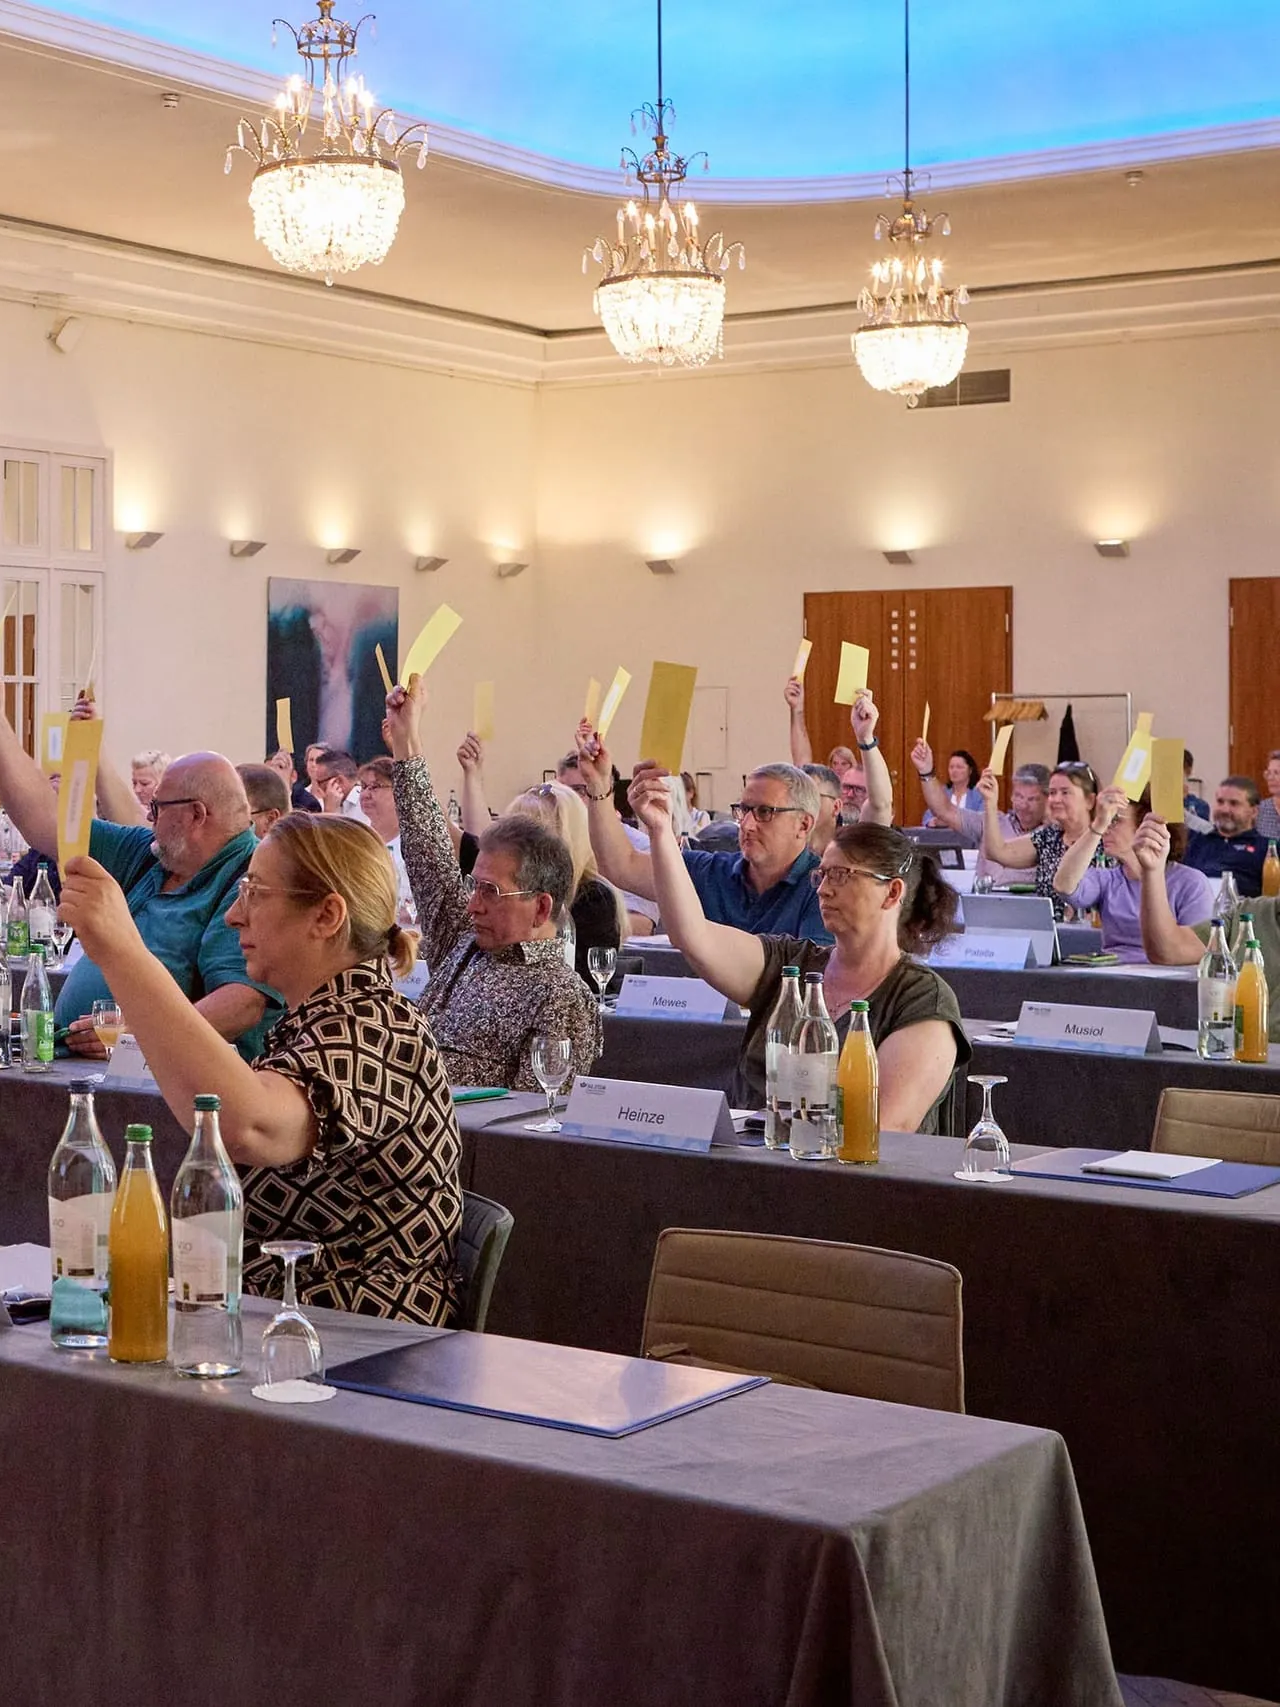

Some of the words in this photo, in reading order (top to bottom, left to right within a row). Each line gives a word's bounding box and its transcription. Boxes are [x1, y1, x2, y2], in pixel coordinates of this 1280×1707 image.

[652, 996, 688, 1008] Mewes
[1064, 1023, 1104, 1037] Musiol
[617, 1106, 665, 1125] Heinze
